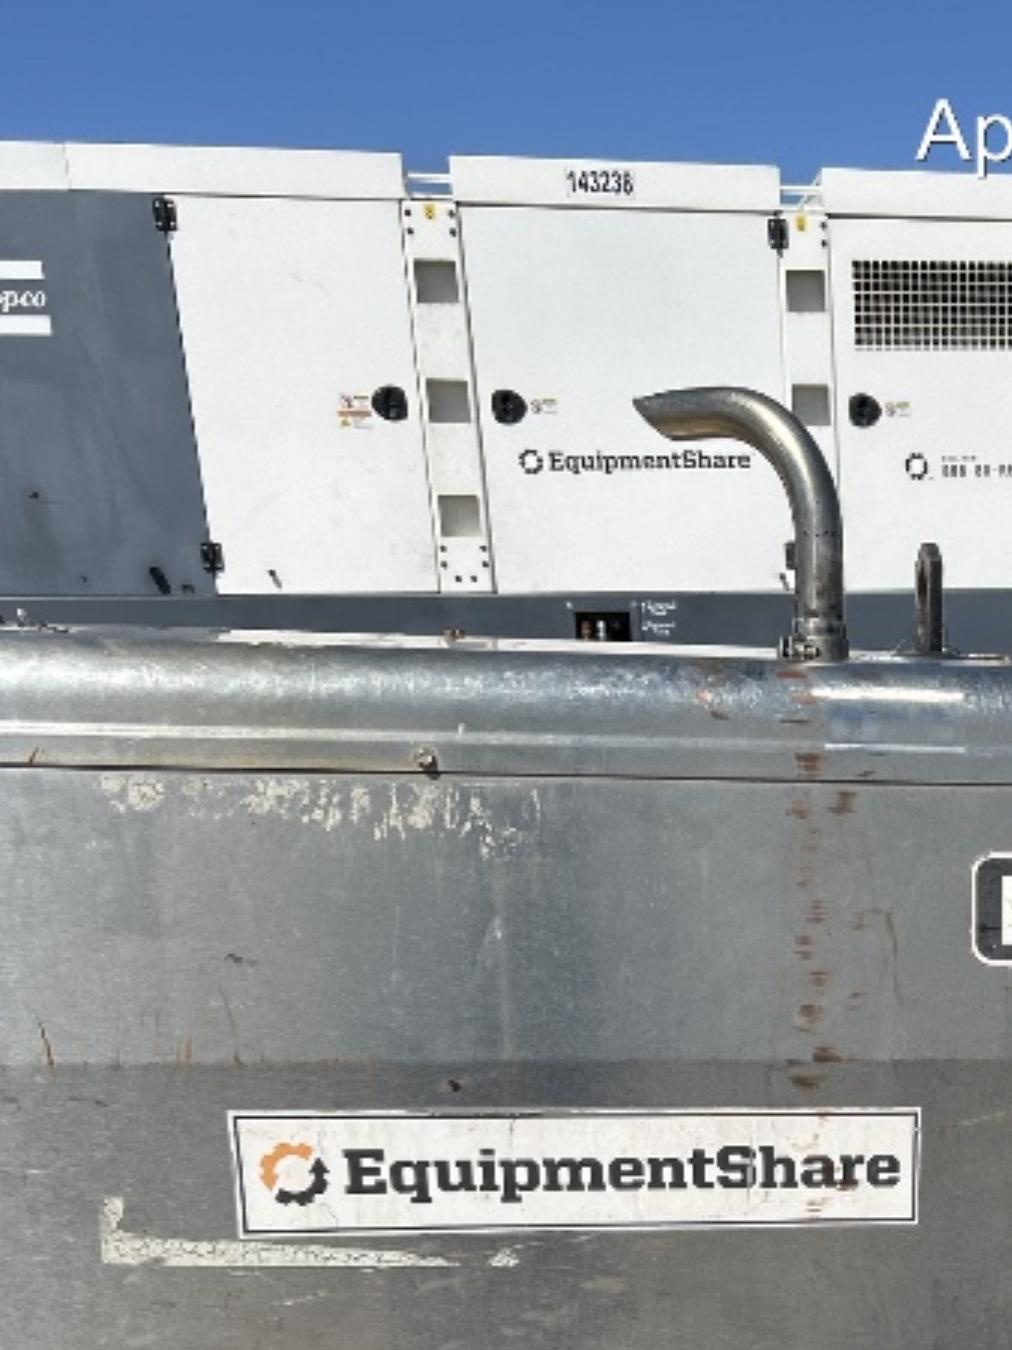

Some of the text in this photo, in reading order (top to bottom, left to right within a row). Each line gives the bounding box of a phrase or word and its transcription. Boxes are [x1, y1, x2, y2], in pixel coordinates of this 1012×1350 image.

[0, 289, 47, 314] pco
[547, 449, 752, 476] EquipmentShare
[343, 1145, 901, 1204] EquipmentShare
